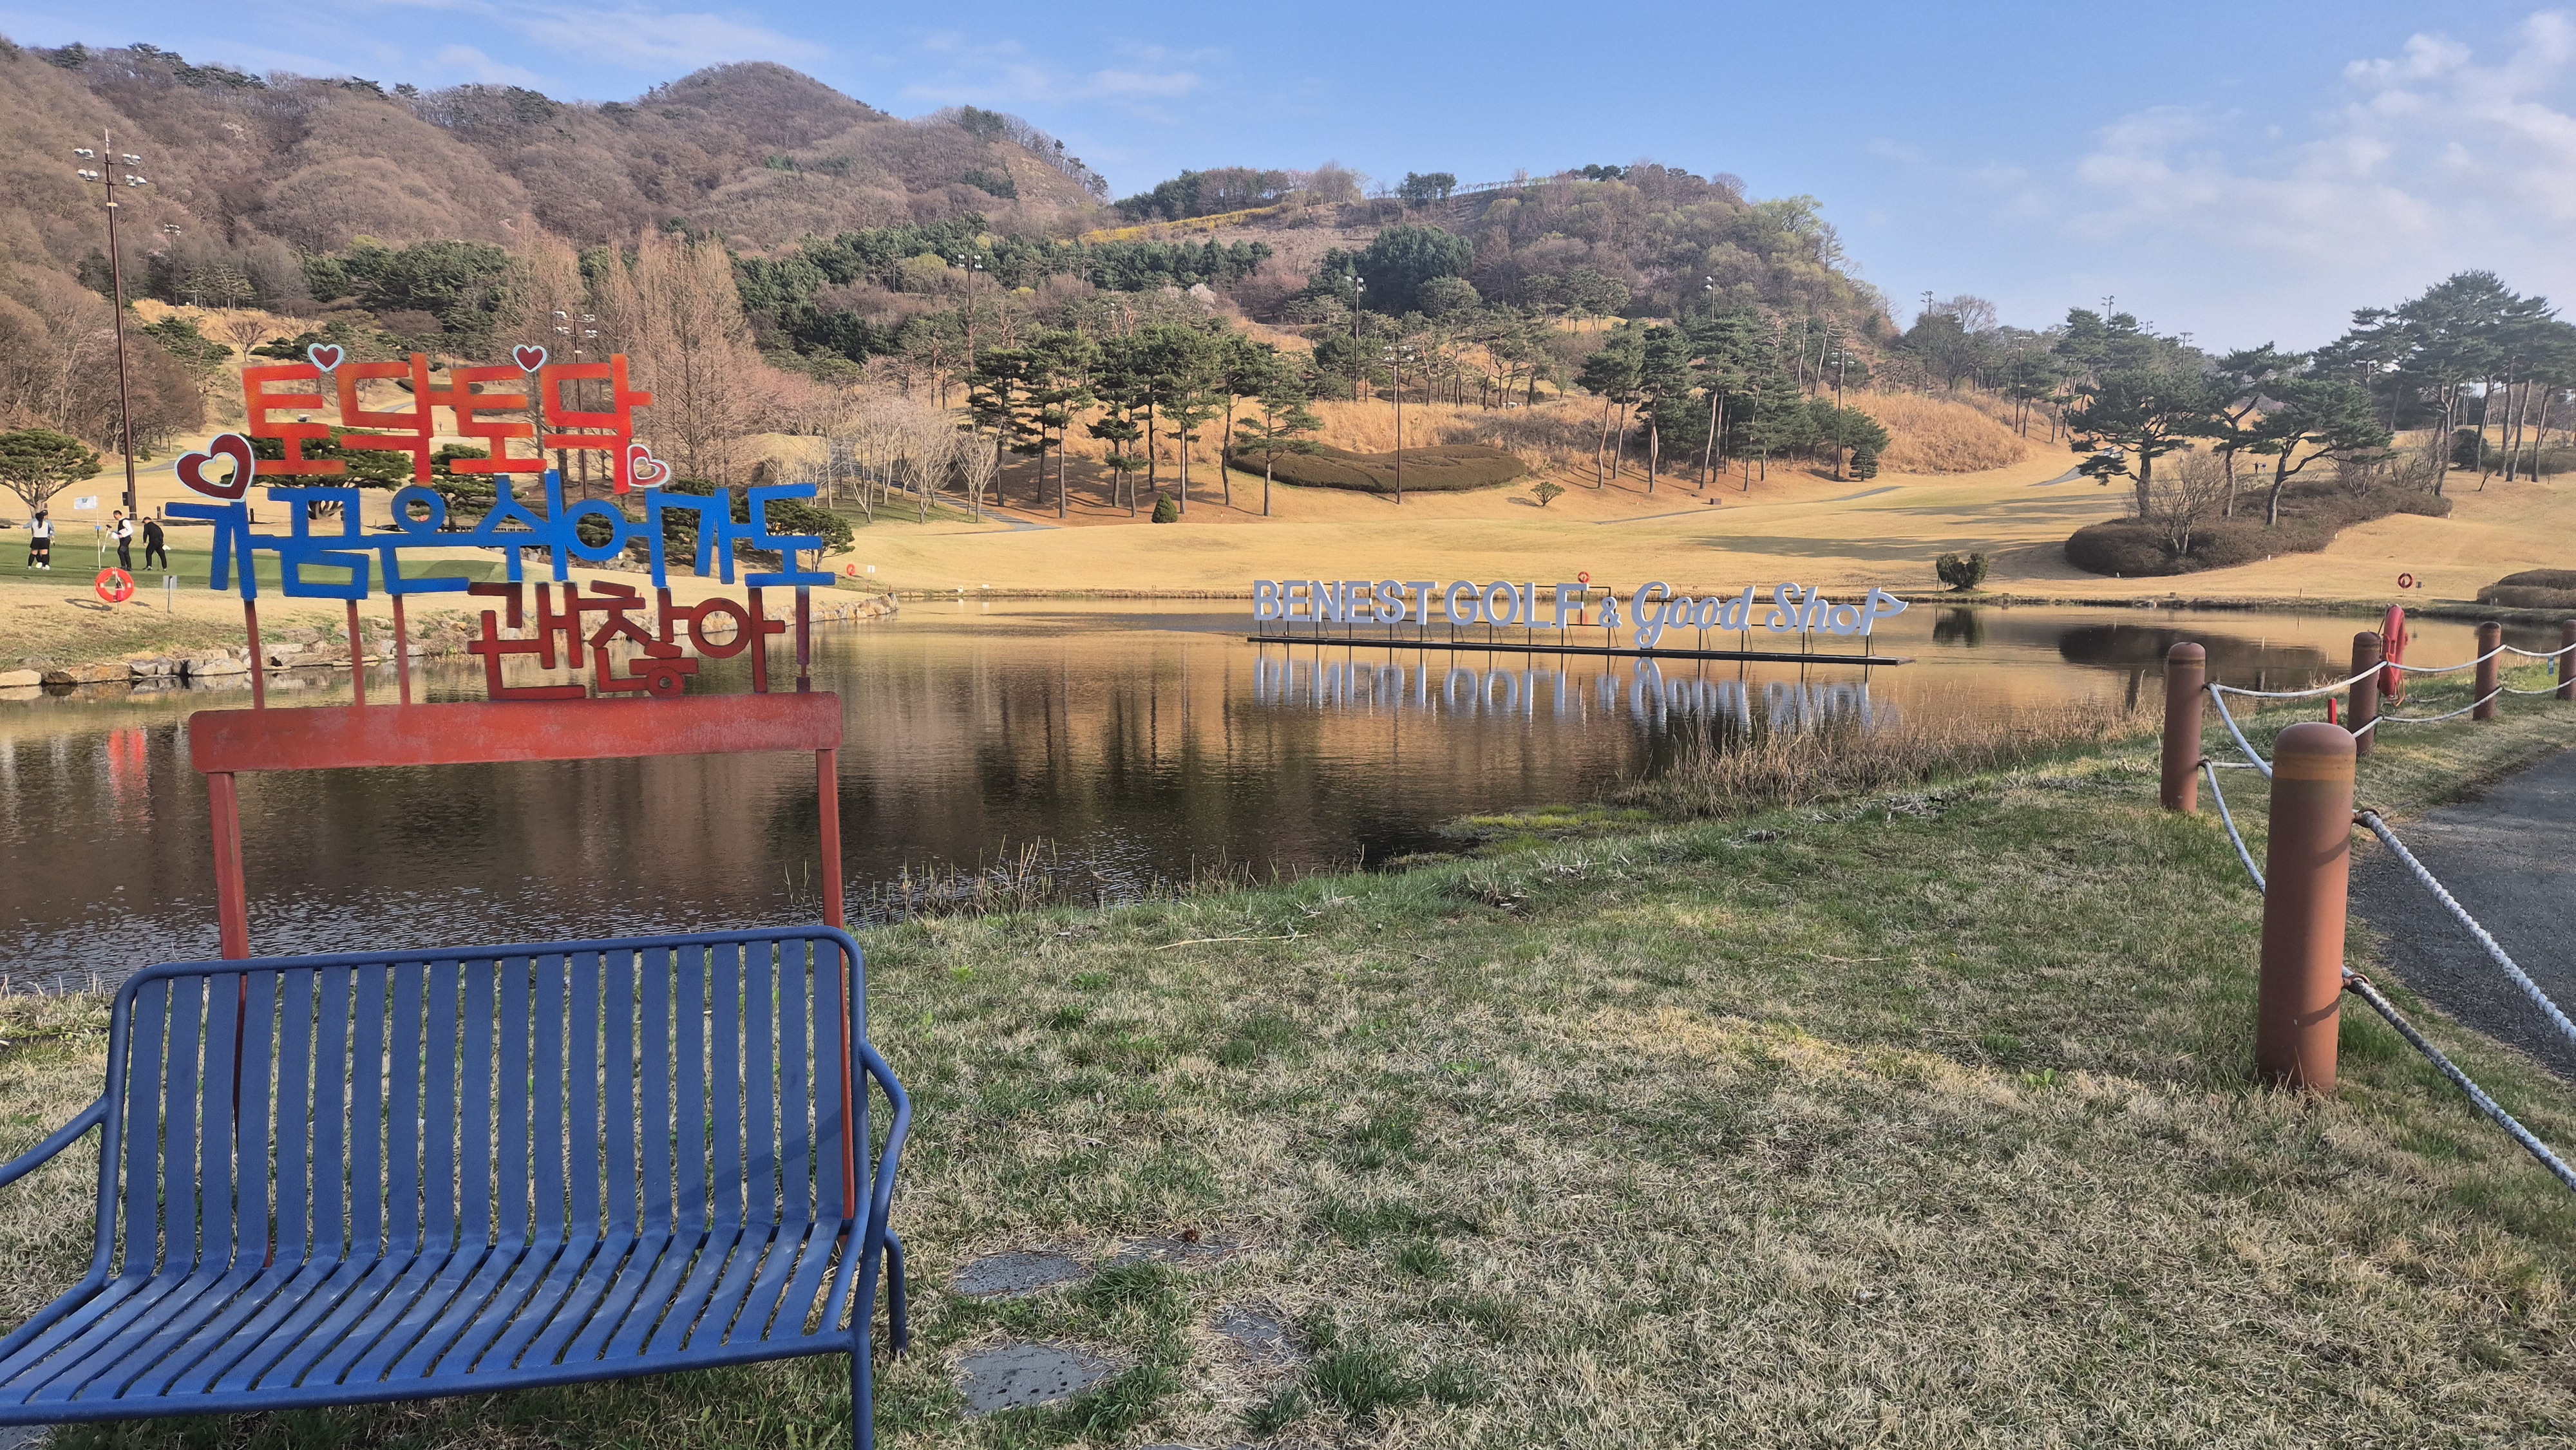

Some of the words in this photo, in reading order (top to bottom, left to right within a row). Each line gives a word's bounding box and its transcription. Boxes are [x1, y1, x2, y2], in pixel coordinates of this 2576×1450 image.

[242, 353, 652, 494] 토닥토닥
[467, 579, 786, 701] 괜찮아
[1253, 579, 1437, 625] BENEST
[1444, 580, 1589, 628] GOLF
[1598, 596, 1622, 628] &
[1631, 581, 1756, 648] Good
